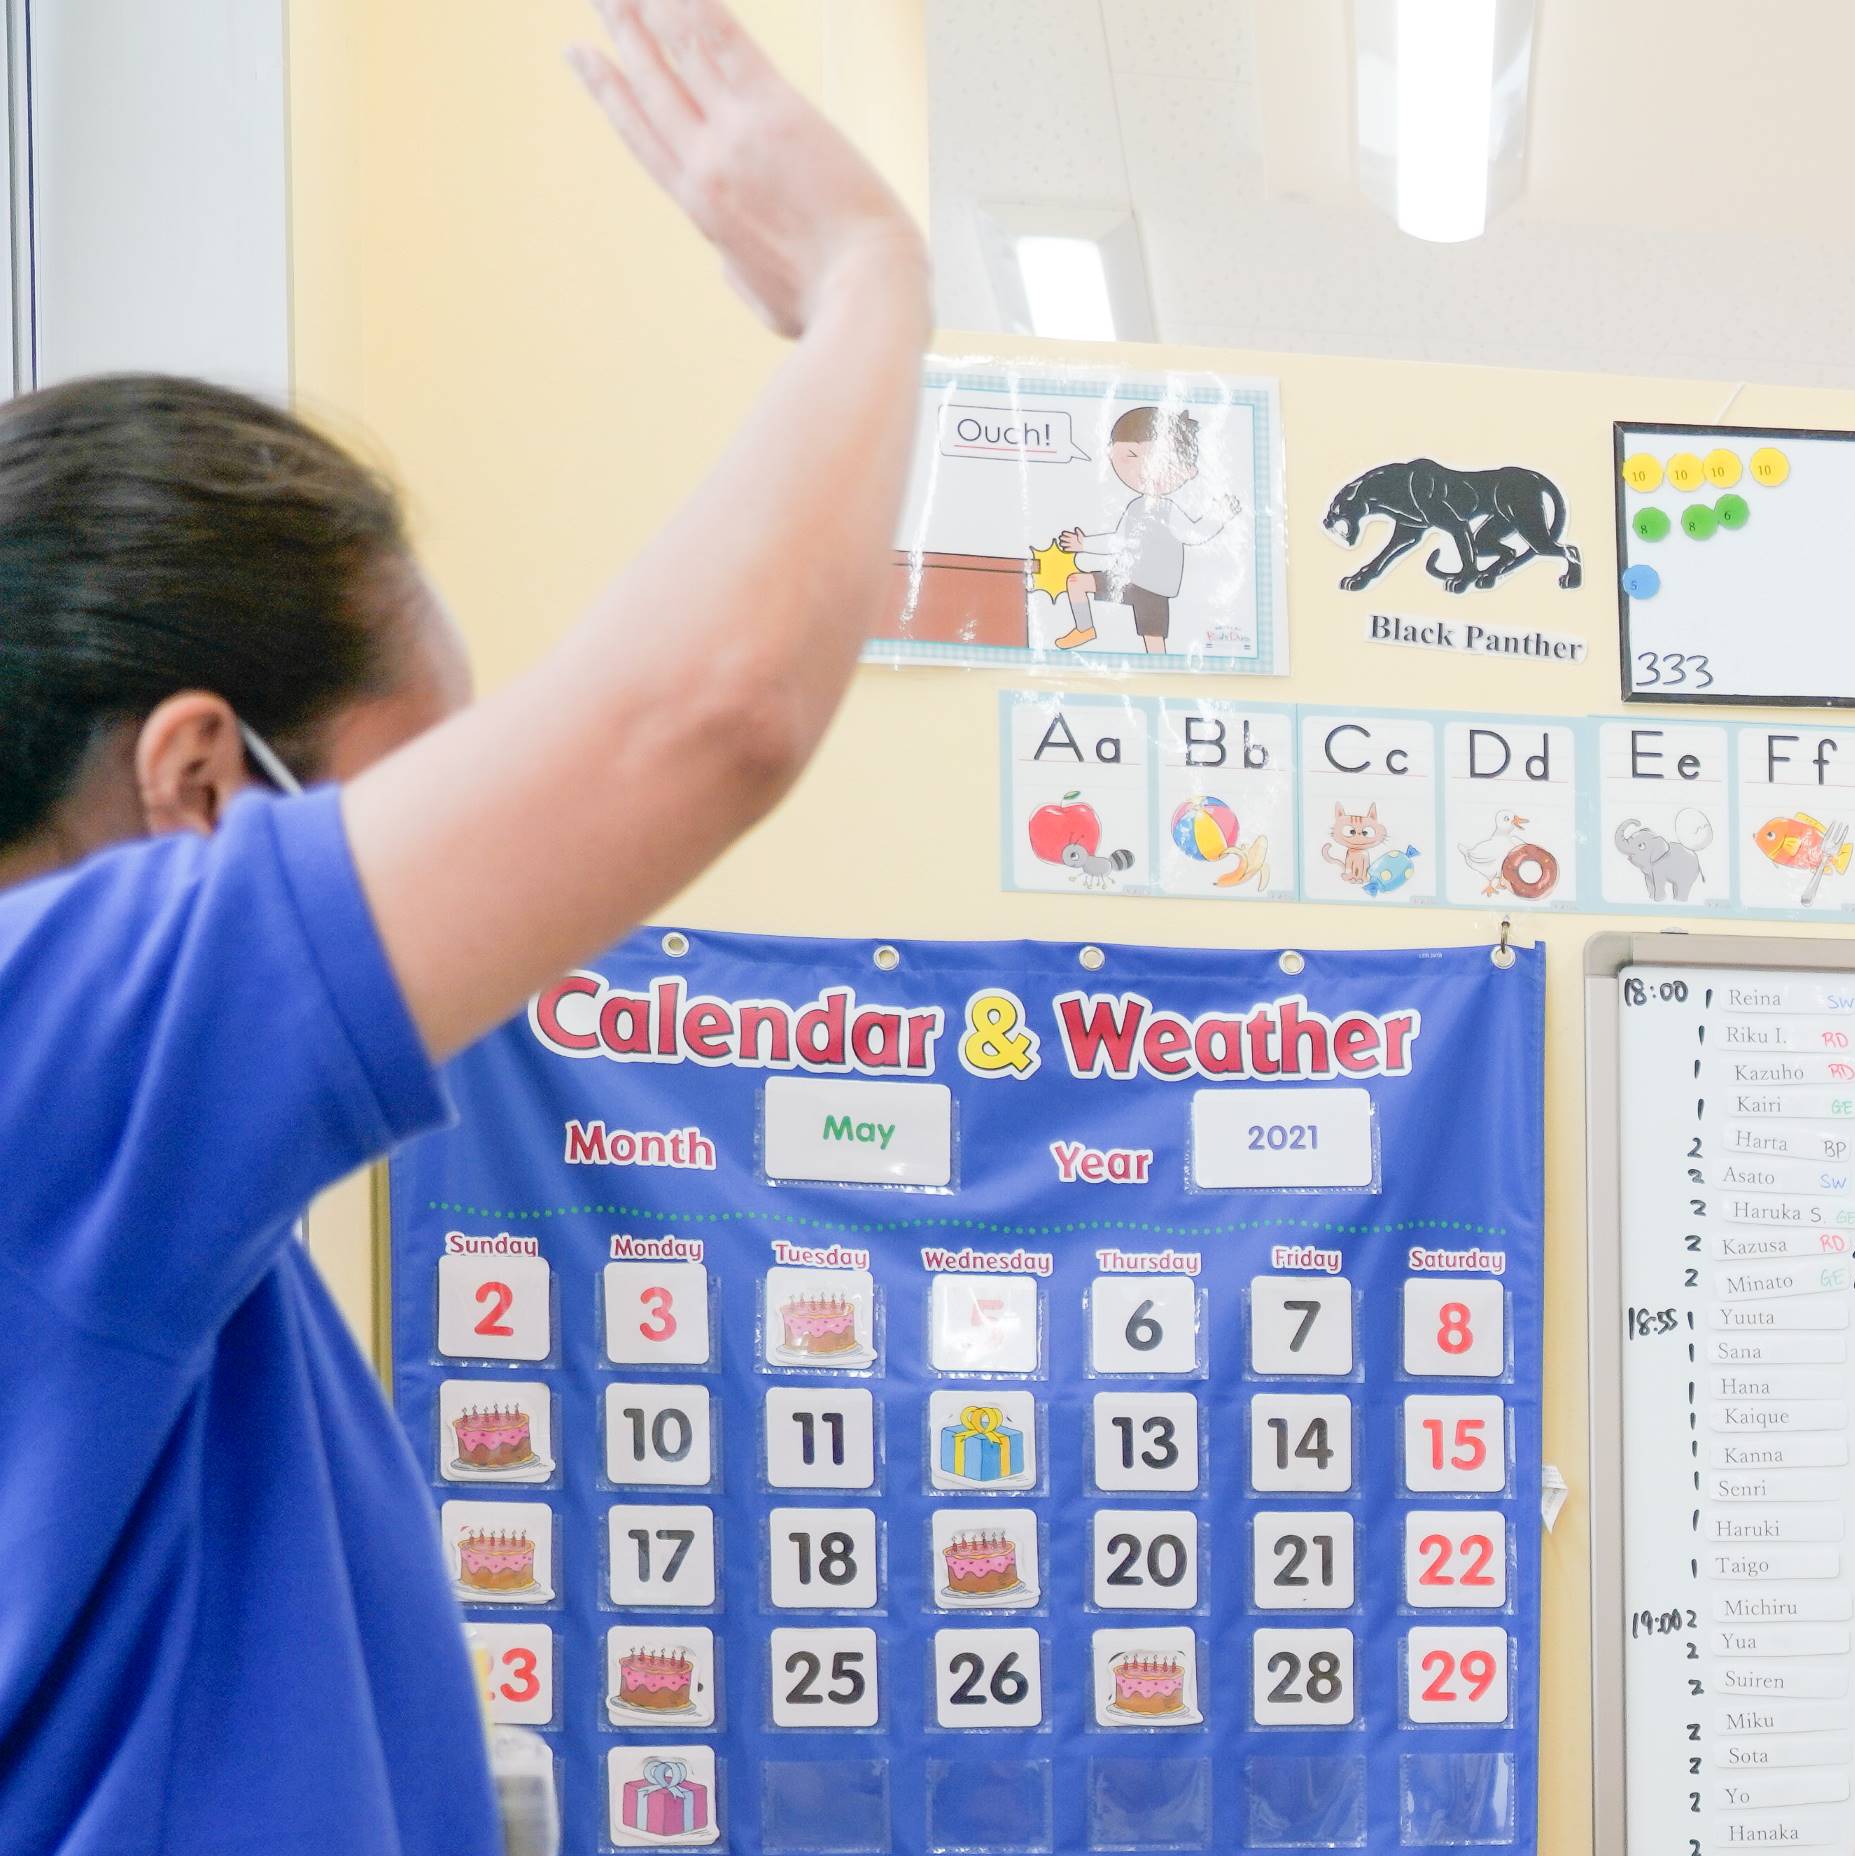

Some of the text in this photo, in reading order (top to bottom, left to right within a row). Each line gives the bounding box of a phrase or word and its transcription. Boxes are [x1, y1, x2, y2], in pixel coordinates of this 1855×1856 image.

[956, 417, 1052, 447] Ouch!
[1369, 613, 1584, 661] Black Panther
[1637, 651, 1714, 689] 333
[1729, 989, 1782, 1007] Reina
[535, 975, 1415, 1076] Calendar & Weather
[1734, 1064, 1805, 1083] Kazuho
[822, 1115, 896, 1150] May
[1247, 1125, 1319, 1151] 2021
[1735, 1130, 1789, 1153] Harta
[568, 1124, 714, 1168] Month
[1054, 1147, 1151, 1182] Year
[1722, 1166, 1775, 1186] Asato
[449, 1234, 1504, 1275] Sunday Monday Tuesday Wednesday Thursday Friday Saturday
[1722, 1238, 1787, 1256] Kazusa
[1726, 1272, 1794, 1295] Minato
[473, 1281, 1475, 1356] 2 3 6 7 8
[1720, 1377, 1771, 1396] Hana
[623, 1407, 1488, 1472] 10 11 13 14 15
[1715, 1519, 1781, 1538] Haruki
[627, 1529, 1496, 1588] 17 18 20 21 22
[1715, 1556, 1770, 1576] Taigo
[1724, 1598, 1799, 1618] Michiru
[784, 1650, 866, 1705] 25
[948, 1651, 1030, 1706] 26
[1266, 1651, 1343, 1705] 28
[1421, 1649, 1497, 1703] 29
[1724, 1670, 1785, 1691] Suiren
[1728, 1824, 1800, 1842] Hanaka
